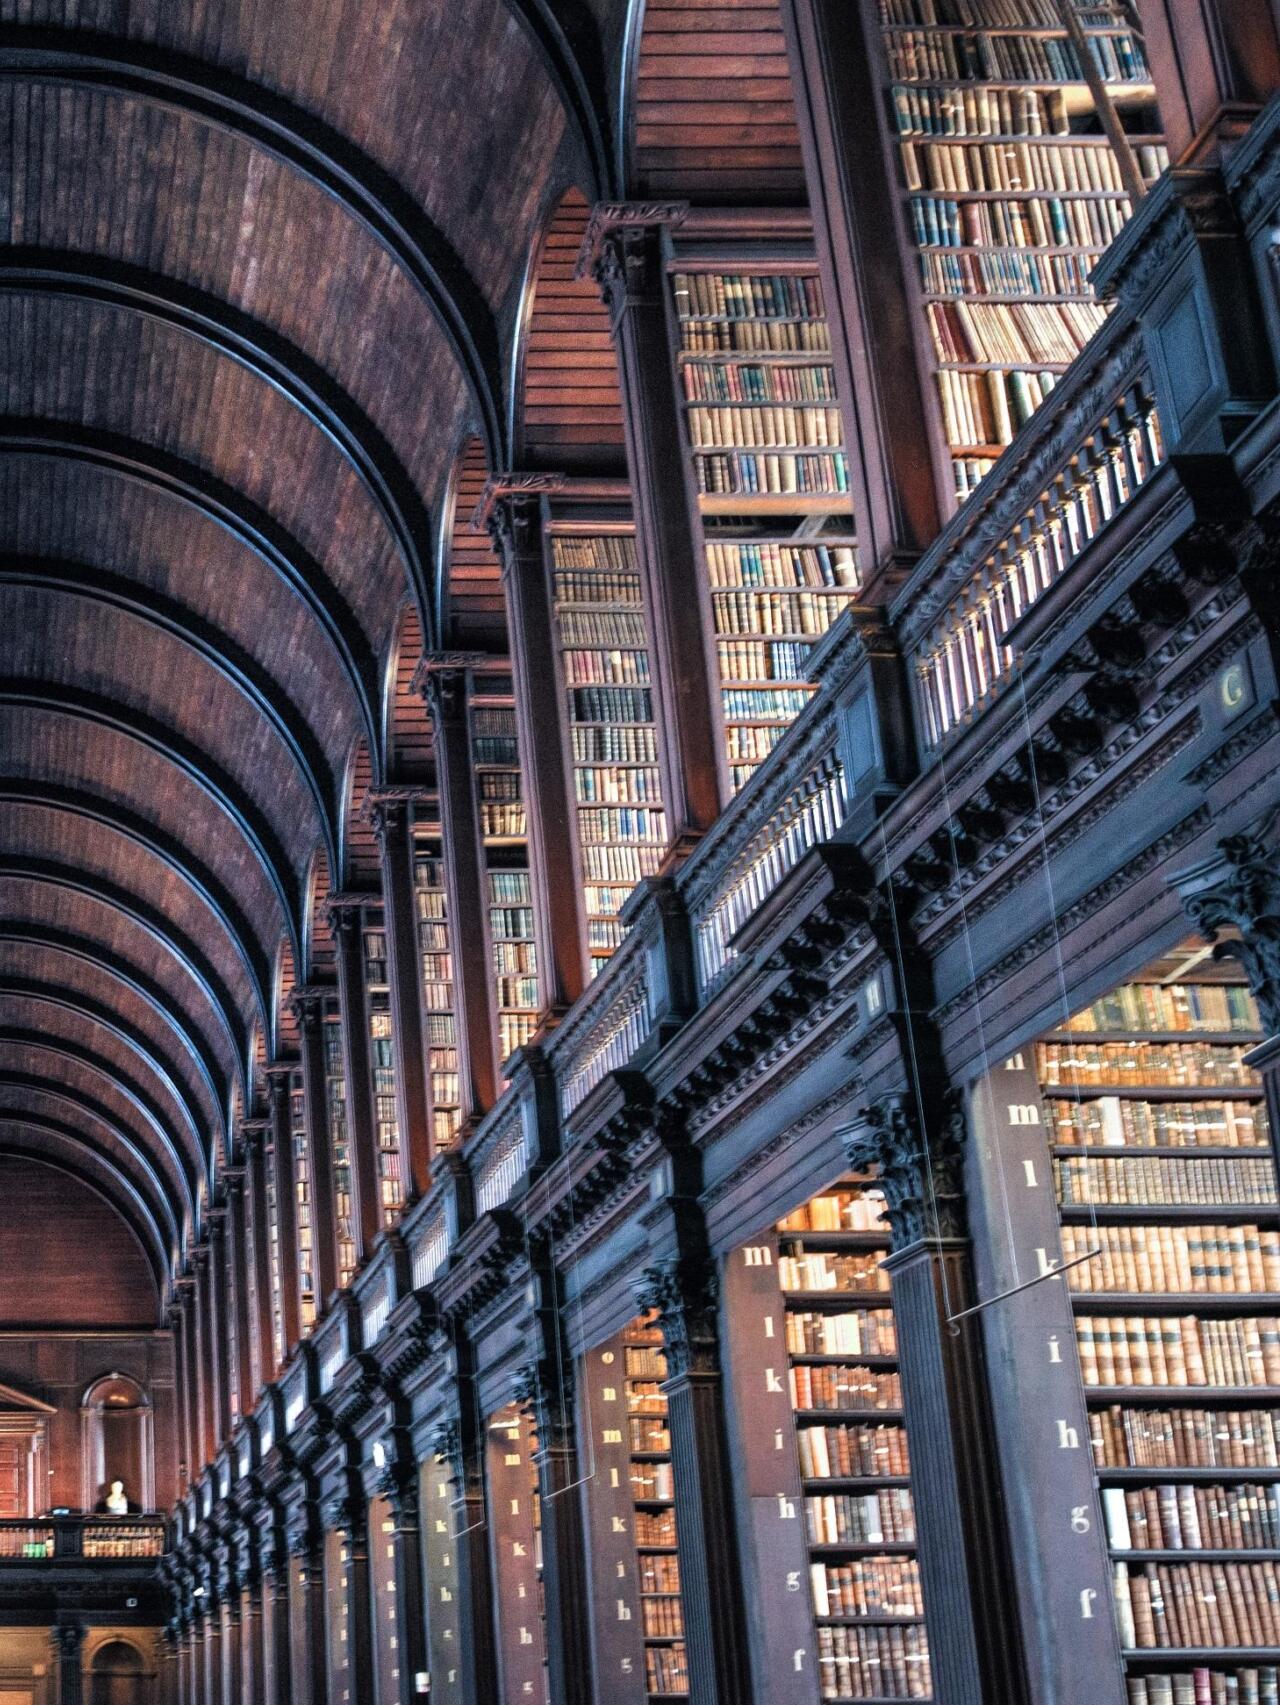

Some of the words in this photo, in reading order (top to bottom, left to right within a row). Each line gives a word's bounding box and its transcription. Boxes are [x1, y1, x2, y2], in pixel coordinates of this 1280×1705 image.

[1008, 1105, 1040, 1125] m
[1023, 1160, 1038, 1186] l
[744, 1247, 772, 1266] m
[1036, 1248, 1061, 1279] k
[765, 1317, 774, 1337] l
[602, 1352, 614, 1363] o
[1048, 1336, 1062, 1362] i
[766, 1369, 783, 1392] k
[604, 1388, 616, 1400] n
[603, 1430, 622, 1443] m
[773, 1429, 784, 1449] i
[1057, 1420, 1079, 1448] h
[611, 1468, 619, 1487] l
[778, 1493, 795, 1518] h
[612, 1517, 626, 1532] k
[1072, 1505, 1089, 1533] g
[617, 1561, 624, 1577] i
[787, 1572, 800, 1591] g
[618, 1600, 631, 1620] h
[1081, 1589, 1096, 1618] f
[621, 1658, 632, 1673] g
[794, 1649, 805, 1671] f
